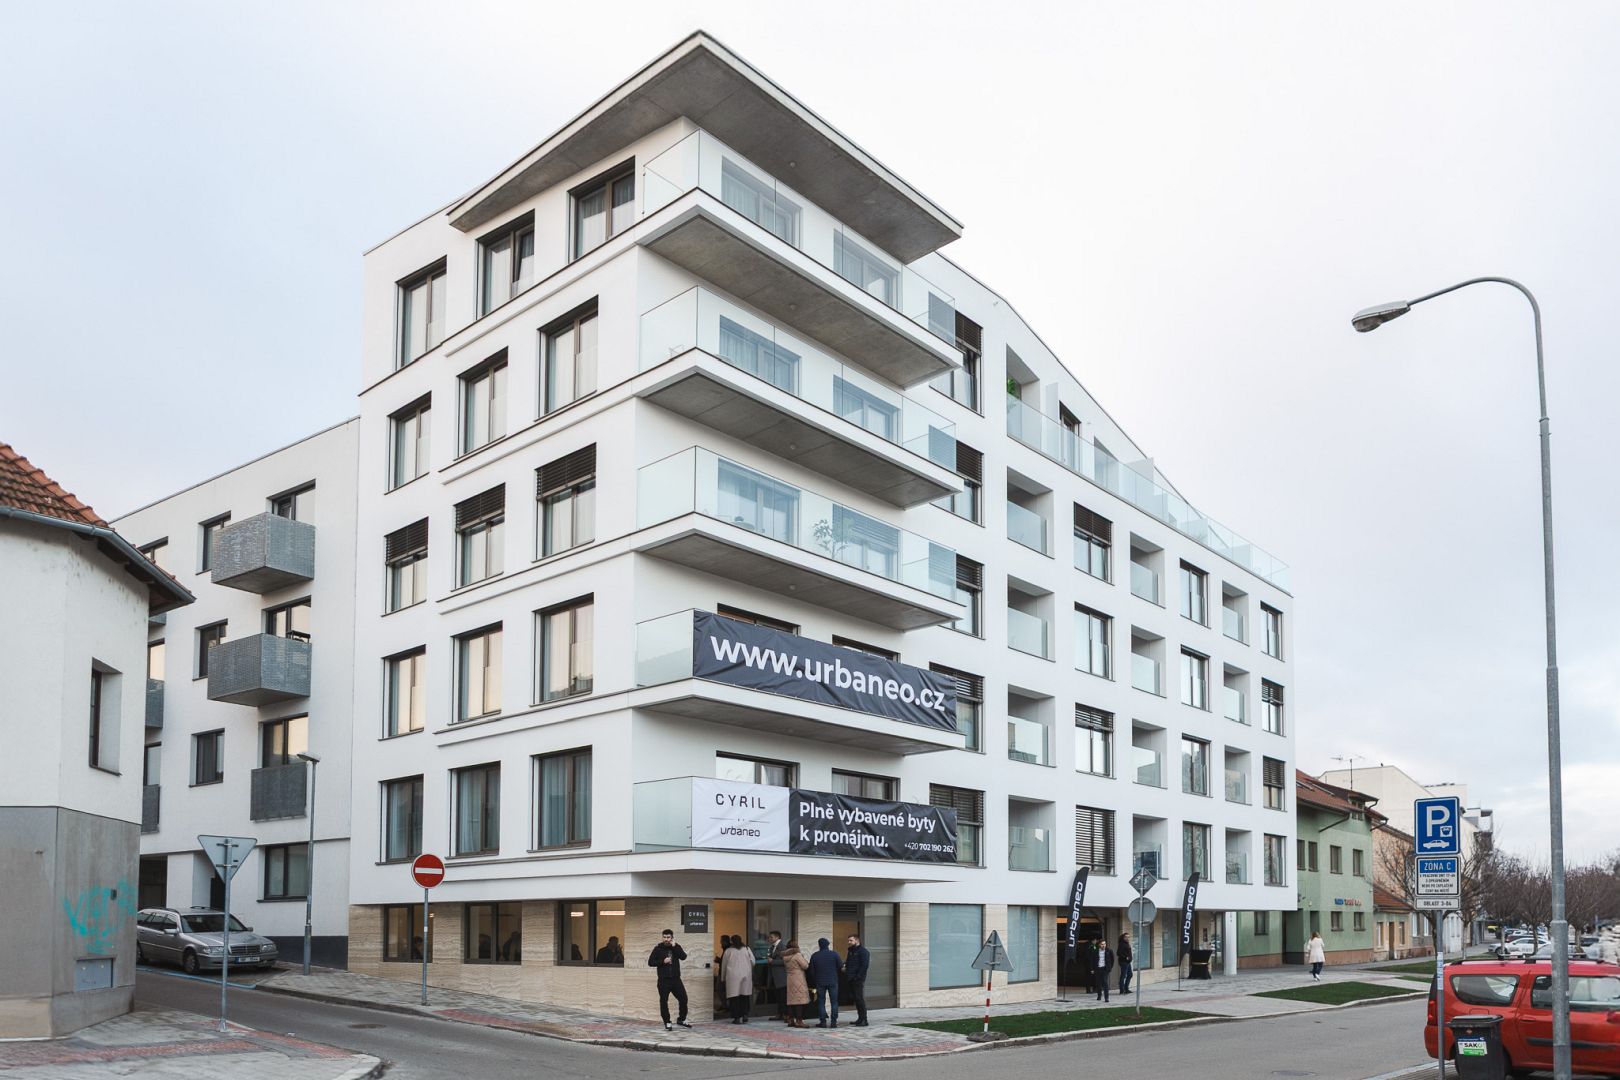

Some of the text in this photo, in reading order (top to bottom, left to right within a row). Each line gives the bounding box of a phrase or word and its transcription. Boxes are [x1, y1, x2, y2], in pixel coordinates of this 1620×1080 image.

[710, 636, 946, 711] www.urbaneo.cz
[716, 794, 766, 809] CYRIL
[720, 826, 761, 838] urbaneo
[800, 802, 936, 834] Plně vybavené byty
[1426, 805, 1450, 837] P
[800, 825, 888, 848] k pronájmu.
[1446, 861, 1452, 870] C
[1068, 882, 1084, 948] urbaneo
[1184, 886, 1196, 944] urbaneo
